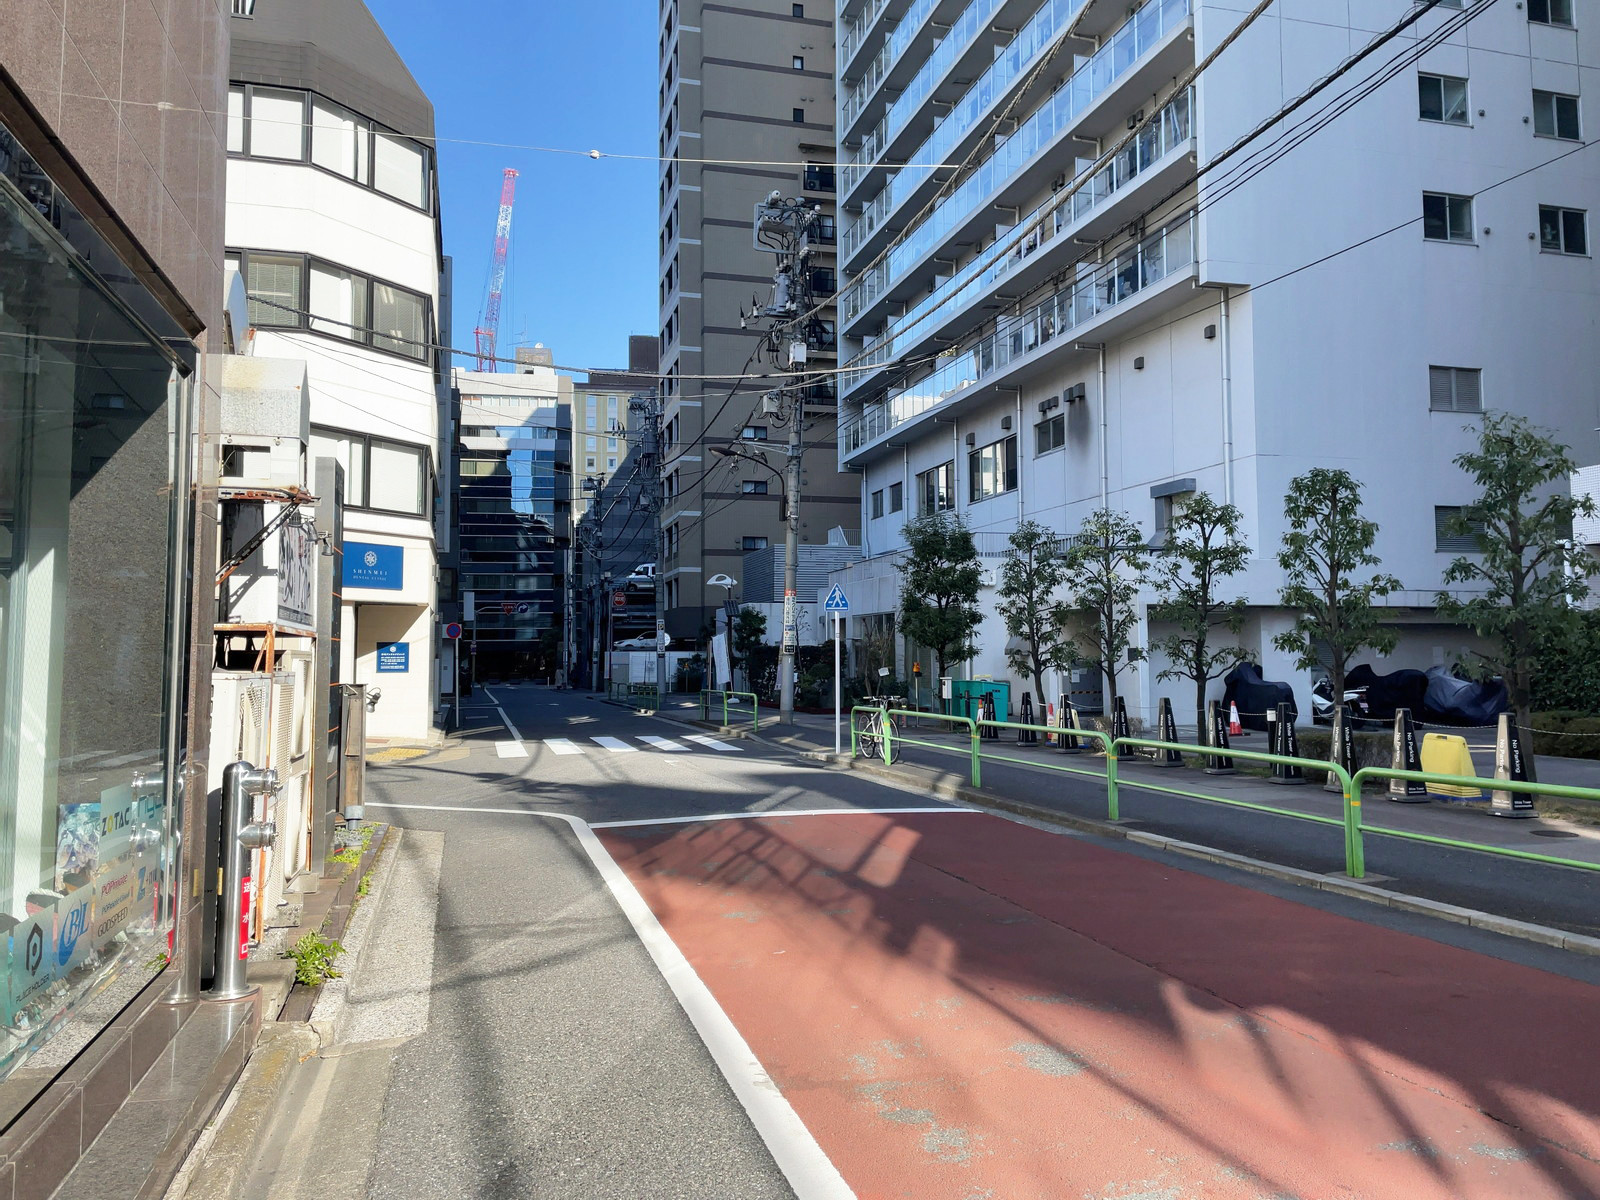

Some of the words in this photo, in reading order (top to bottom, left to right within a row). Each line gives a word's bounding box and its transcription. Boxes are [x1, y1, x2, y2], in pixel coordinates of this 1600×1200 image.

[1407, 732, 1412, 741] No
[1499, 739, 1505, 748] No
[1512, 739, 1518, 748] No
[102, 807, 130, 836] ZOTAC
[98, 906, 128, 938] GODSPEED
